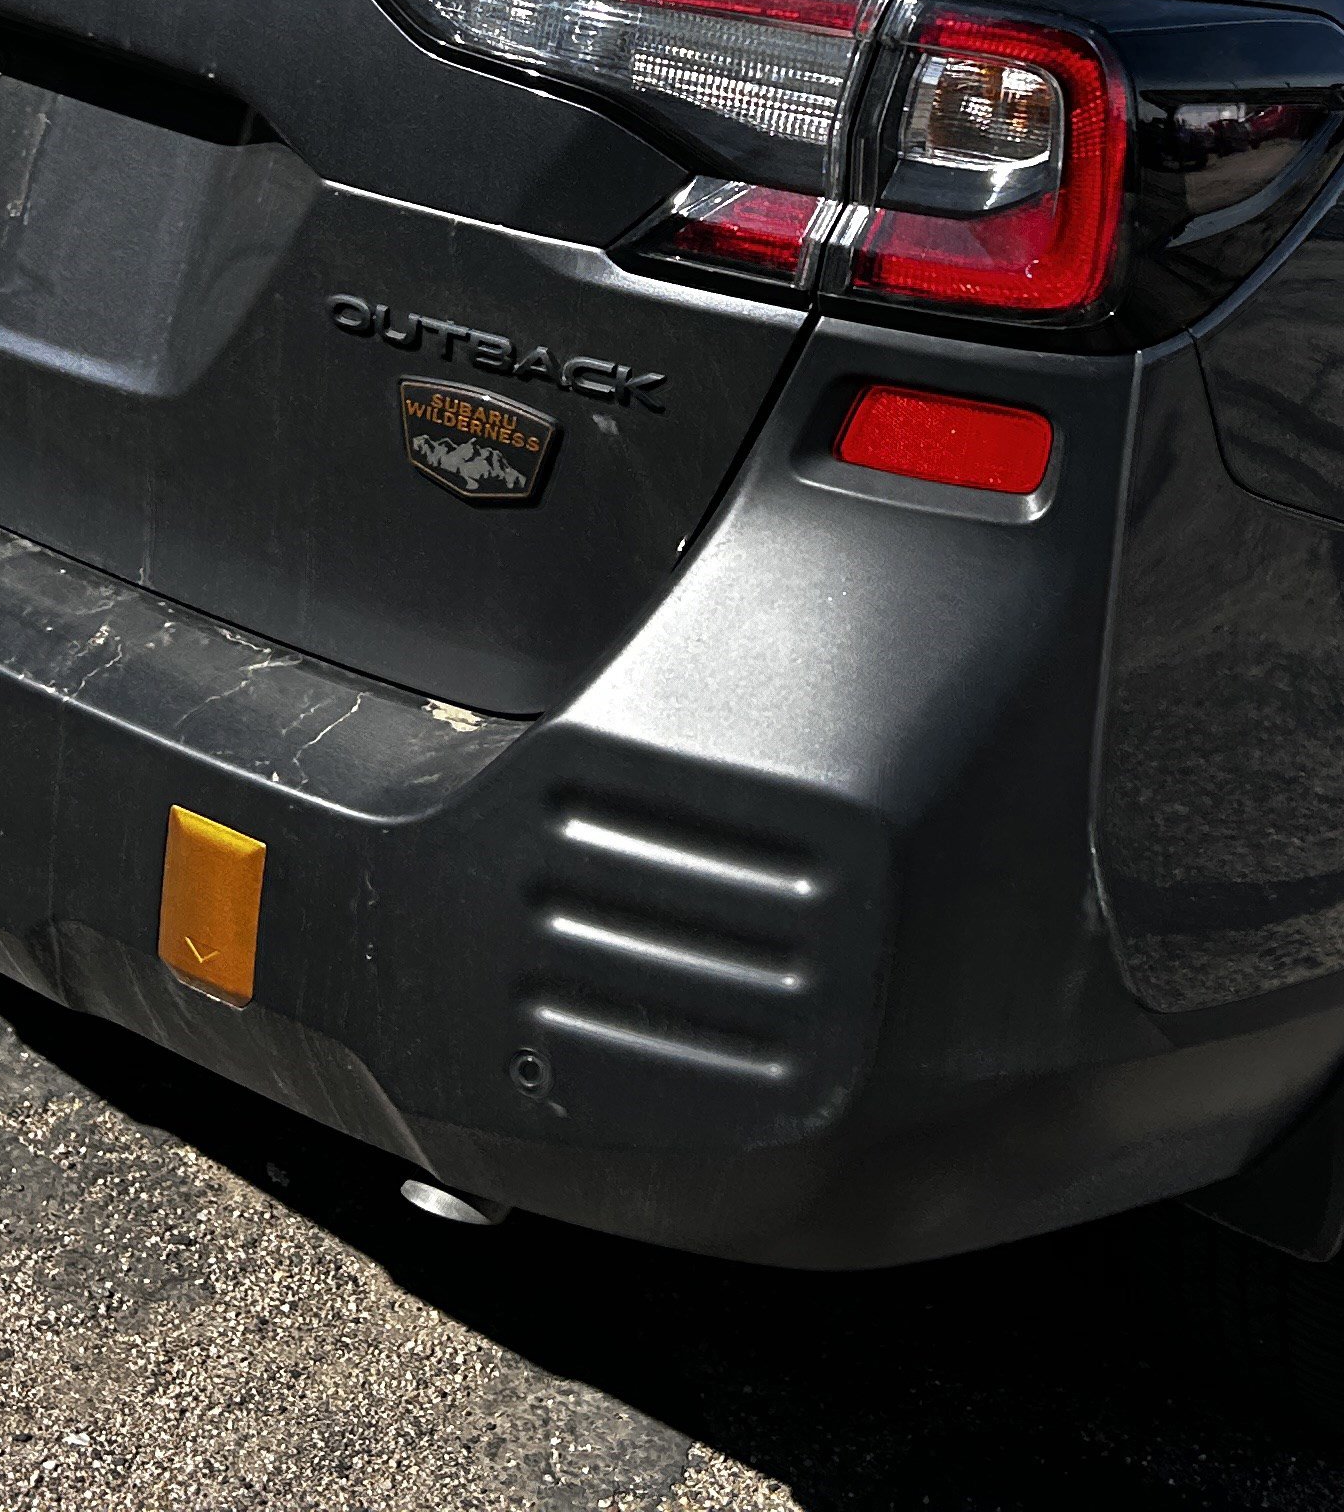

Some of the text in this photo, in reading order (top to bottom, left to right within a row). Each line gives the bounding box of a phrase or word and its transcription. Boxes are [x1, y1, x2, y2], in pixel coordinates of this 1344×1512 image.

[326, 293, 668, 413] OUTBACK
[406, 400, 541, 452] WILDERNESS
[431, 393, 518, 431] SUBARU
